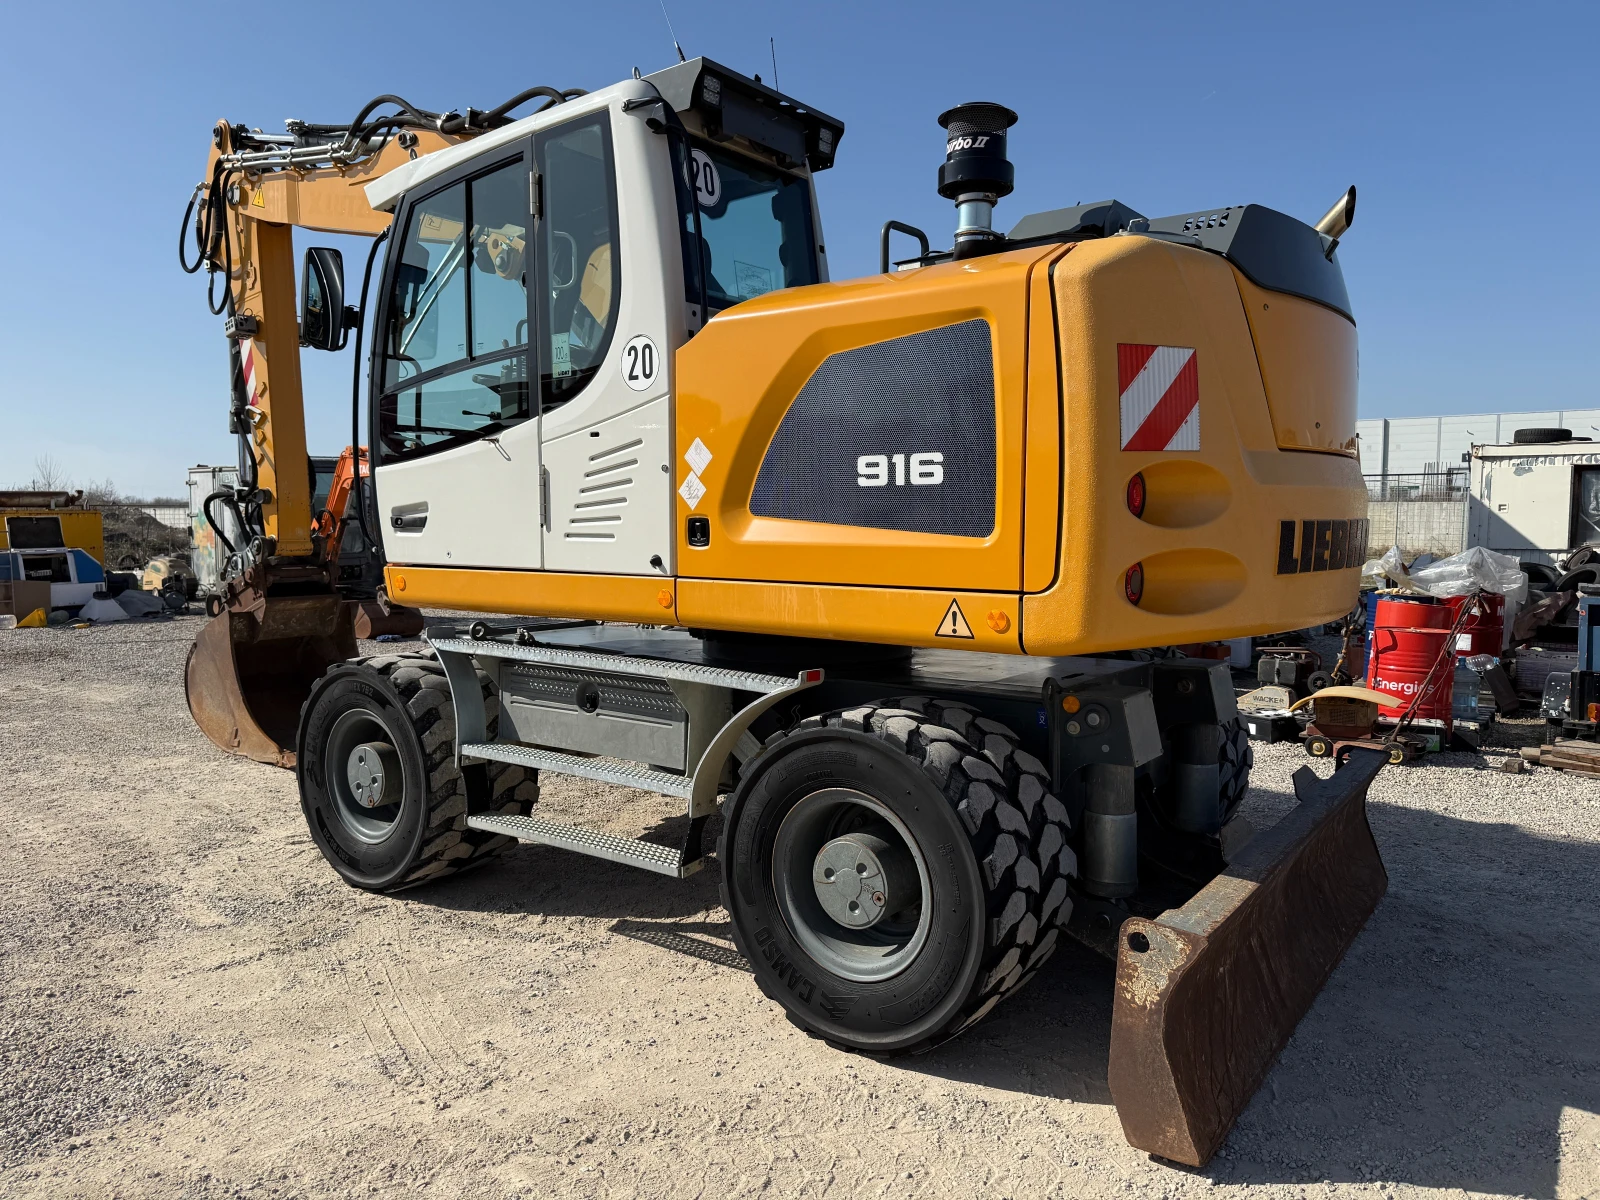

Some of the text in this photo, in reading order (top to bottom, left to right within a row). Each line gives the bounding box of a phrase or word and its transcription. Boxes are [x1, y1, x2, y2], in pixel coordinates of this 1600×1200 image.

[690, 156, 715, 196] 20
[628, 343, 653, 381] 20
[857, 452, 944, 486] 916
[753, 924, 817, 1006] CAMSO
